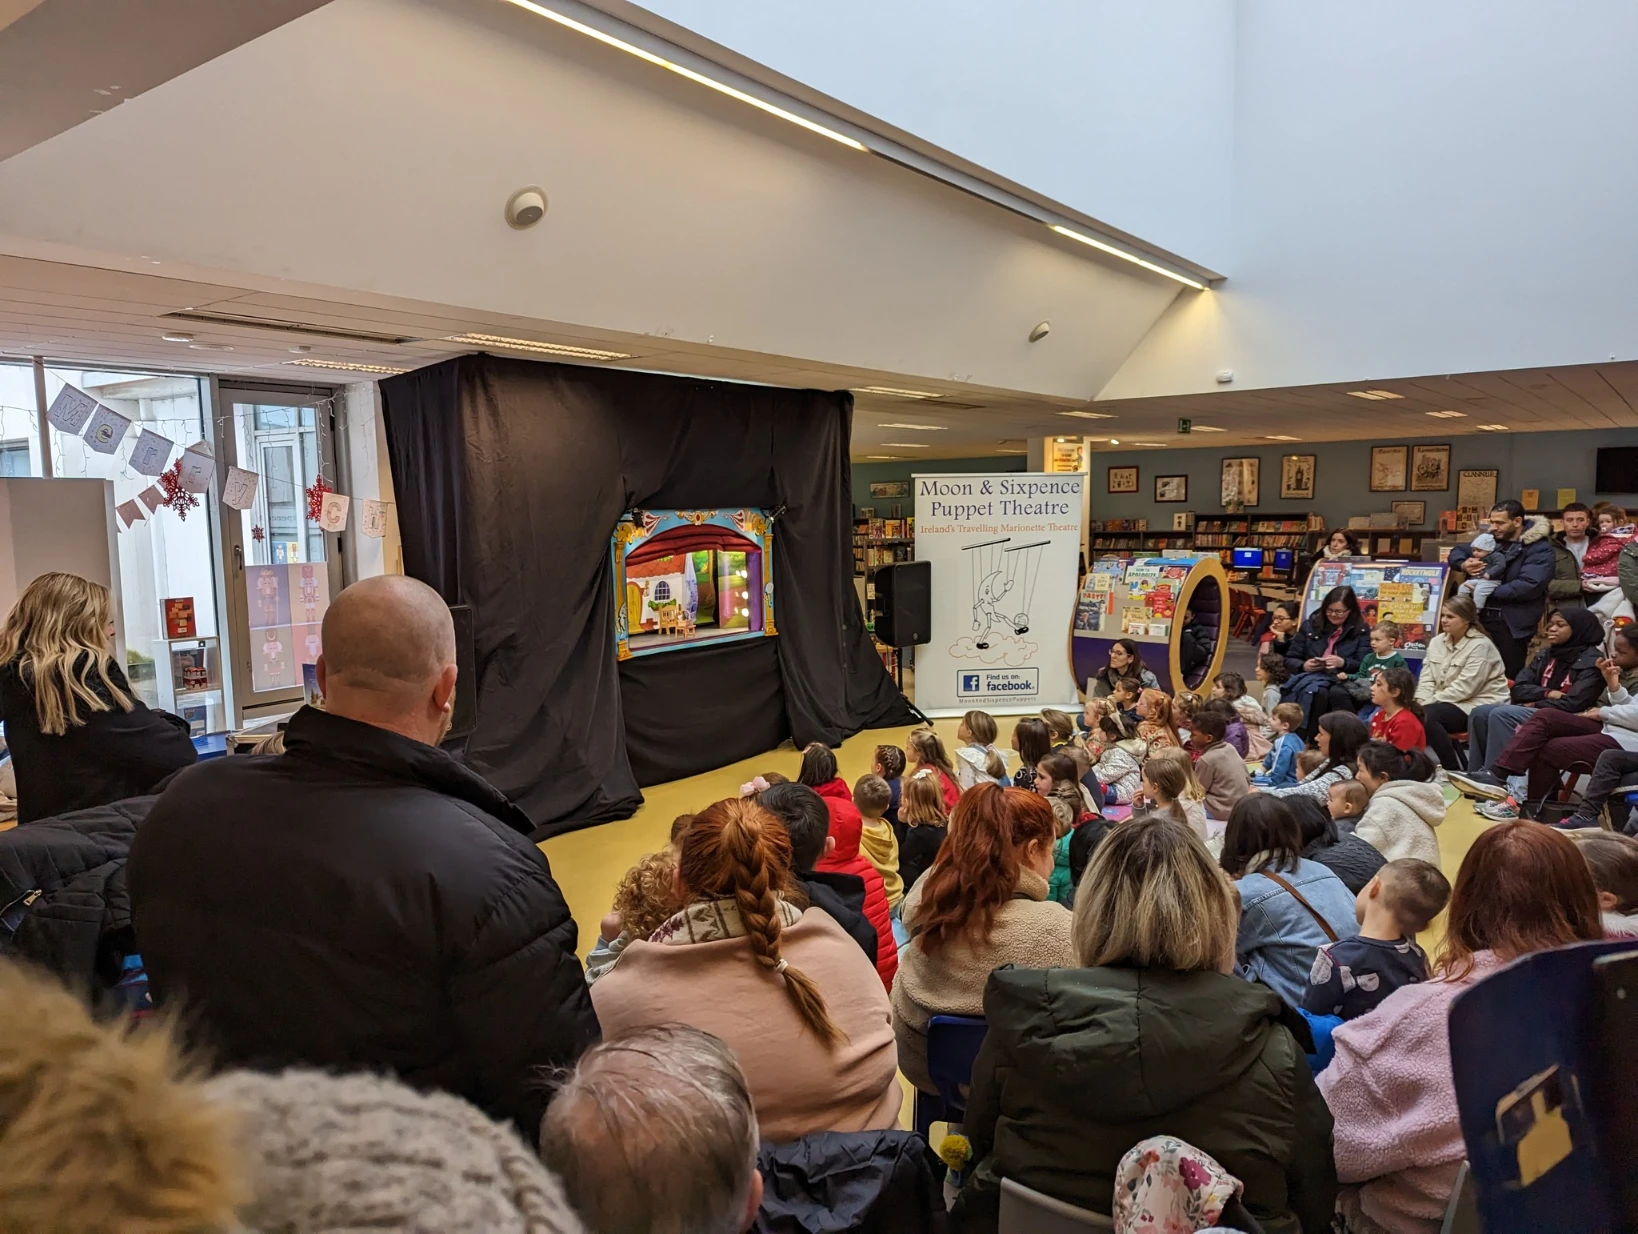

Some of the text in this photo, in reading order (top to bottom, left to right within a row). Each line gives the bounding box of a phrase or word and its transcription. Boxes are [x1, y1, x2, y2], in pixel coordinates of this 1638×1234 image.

[919, 479, 1081, 499] Moon & Sixpence
[930, 499, 1070, 521] Puppet Theatre
[920, 522, 1079, 535] Ireland's Travelling Marionette Theatre
[986, 680, 1032, 692] facebook
